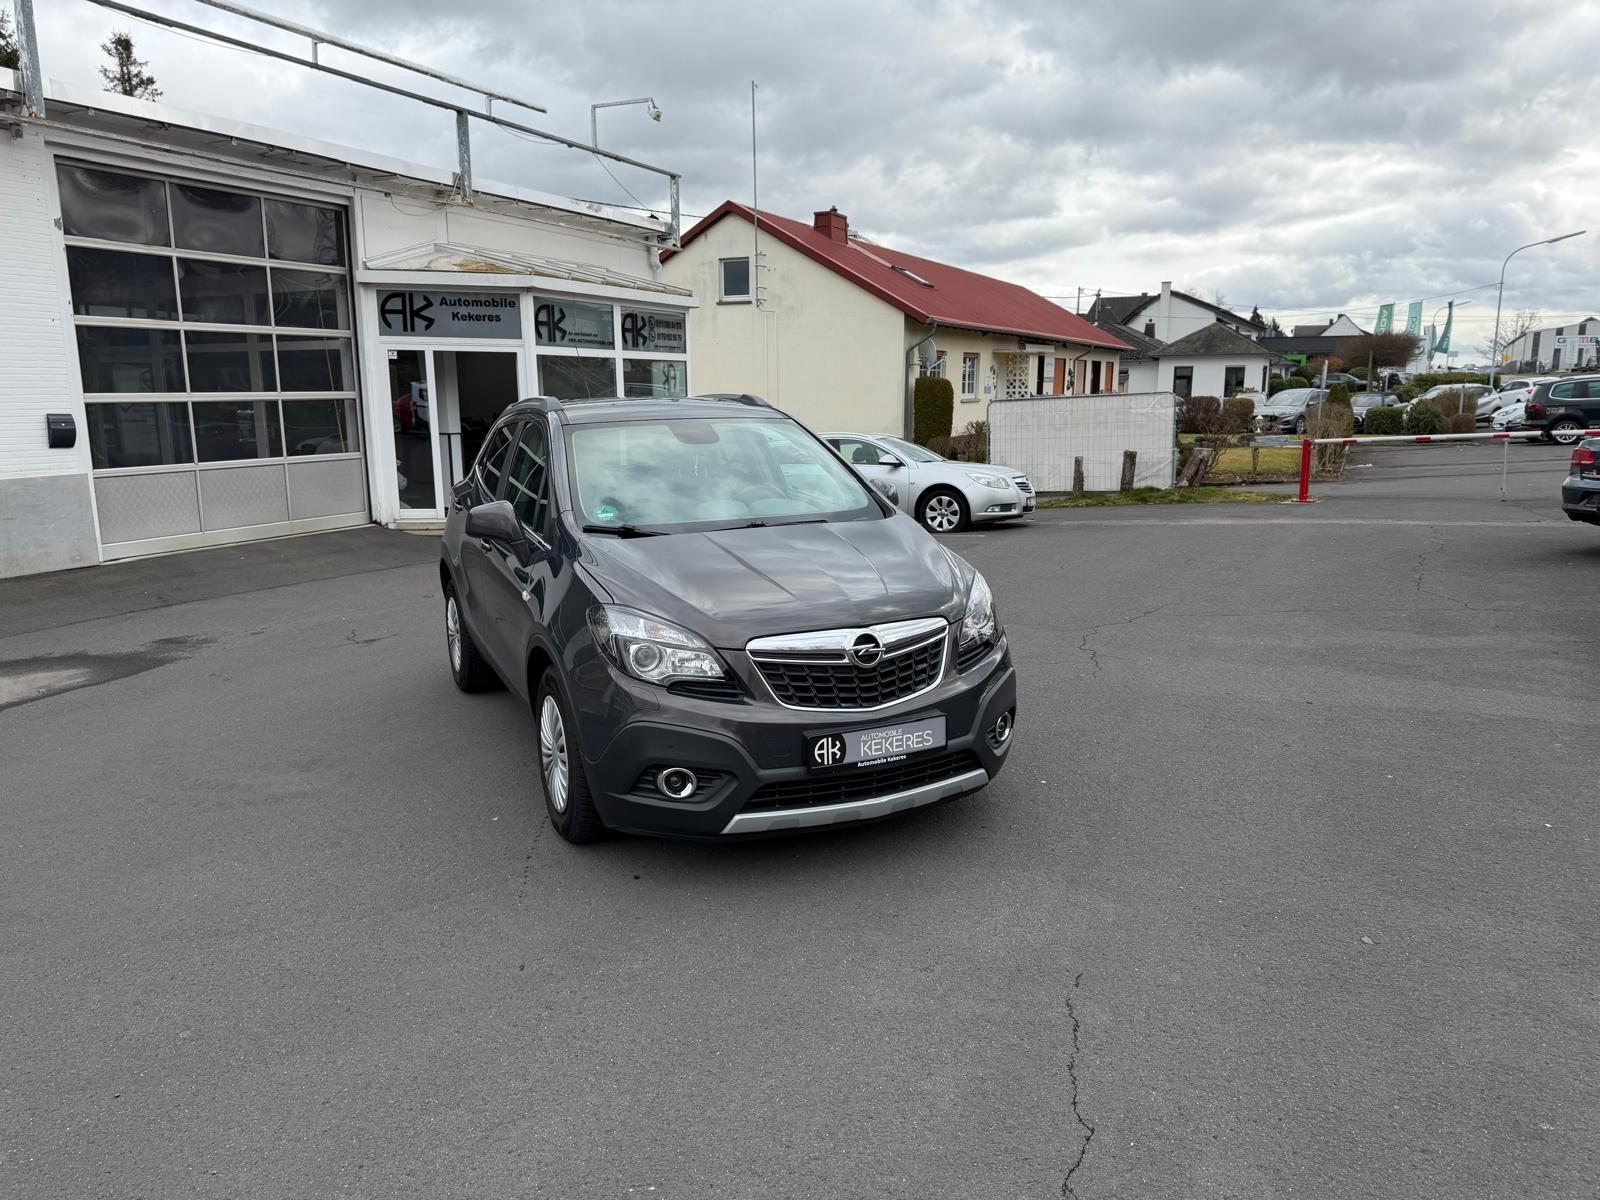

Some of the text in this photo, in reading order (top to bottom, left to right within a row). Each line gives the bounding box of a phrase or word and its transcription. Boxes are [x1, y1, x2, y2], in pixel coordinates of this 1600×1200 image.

[439, 296, 516, 309] Automobile
[451, 311, 502, 322] Kekeres
[860, 729, 903, 741] AUTOMOBILE
[860, 730, 933, 757] KEKERES
[857, 754, 907, 768] Automobile Kekeres
